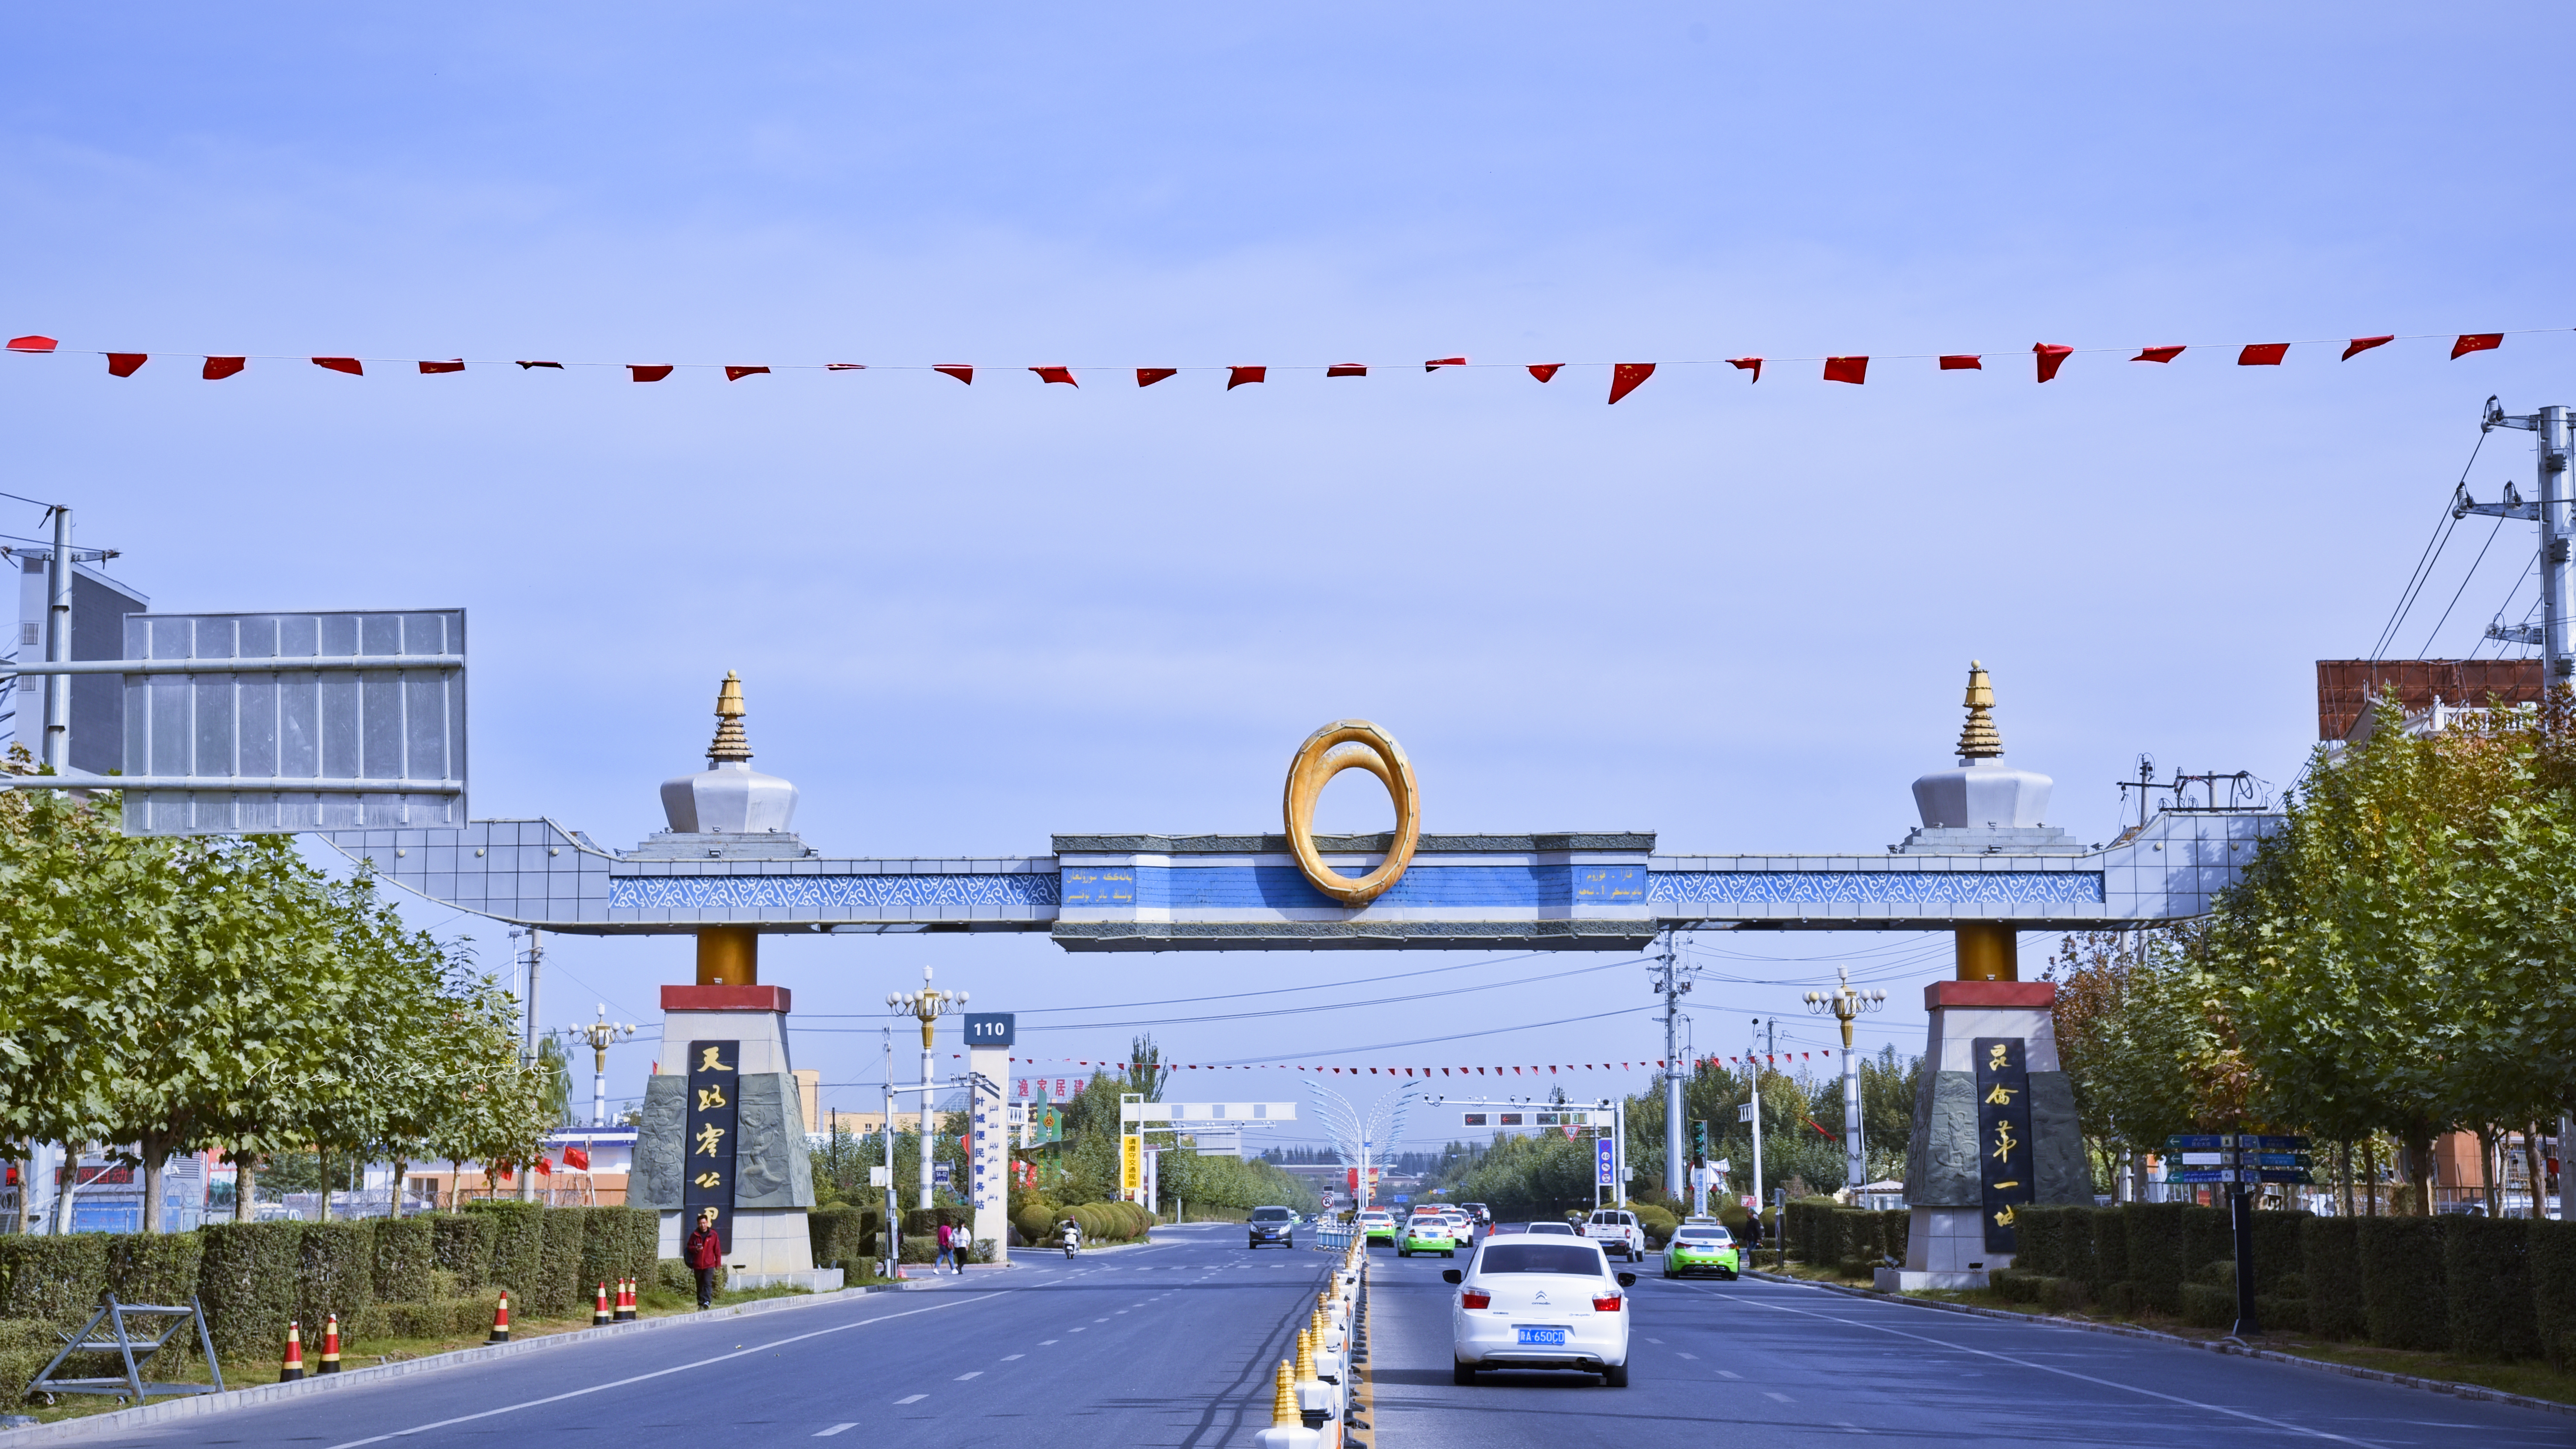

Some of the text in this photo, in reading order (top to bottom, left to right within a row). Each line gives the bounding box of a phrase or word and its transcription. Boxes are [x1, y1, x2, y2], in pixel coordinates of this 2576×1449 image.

[974, 1023, 1005, 1036] 110
[974, 1096, 986, 1210] 叶城便民警务站
[1128, 1138, 1136, 1187] 请遵守交通规则
